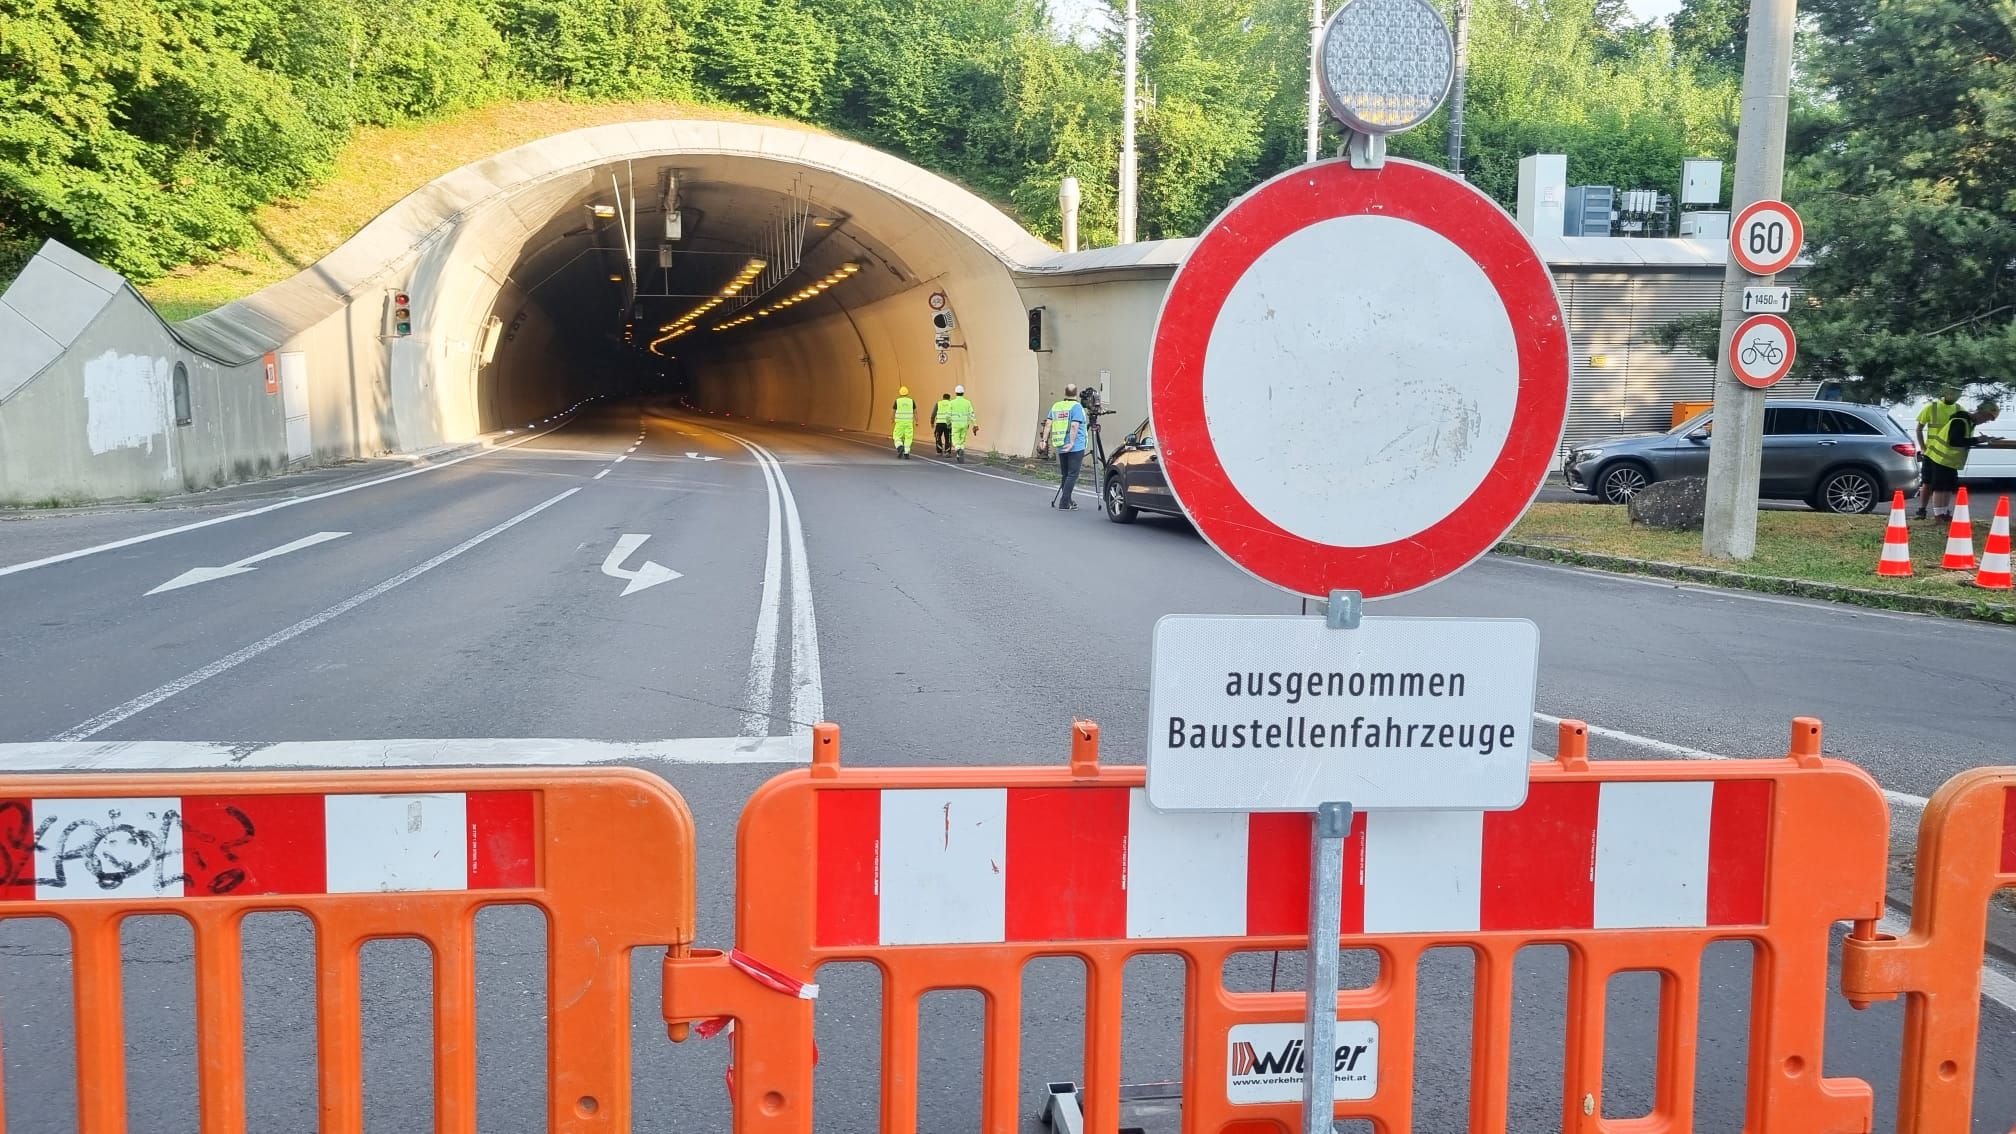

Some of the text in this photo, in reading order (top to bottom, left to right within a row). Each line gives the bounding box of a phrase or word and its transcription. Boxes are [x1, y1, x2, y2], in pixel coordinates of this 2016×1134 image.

[1750, 222, 1783, 254] 60
[1226, 671, 1466, 704] ausgenommen
[1168, 716, 1515, 755] Baustellenfahrzeuge
[1246, 1040, 1367, 1074] Wier
